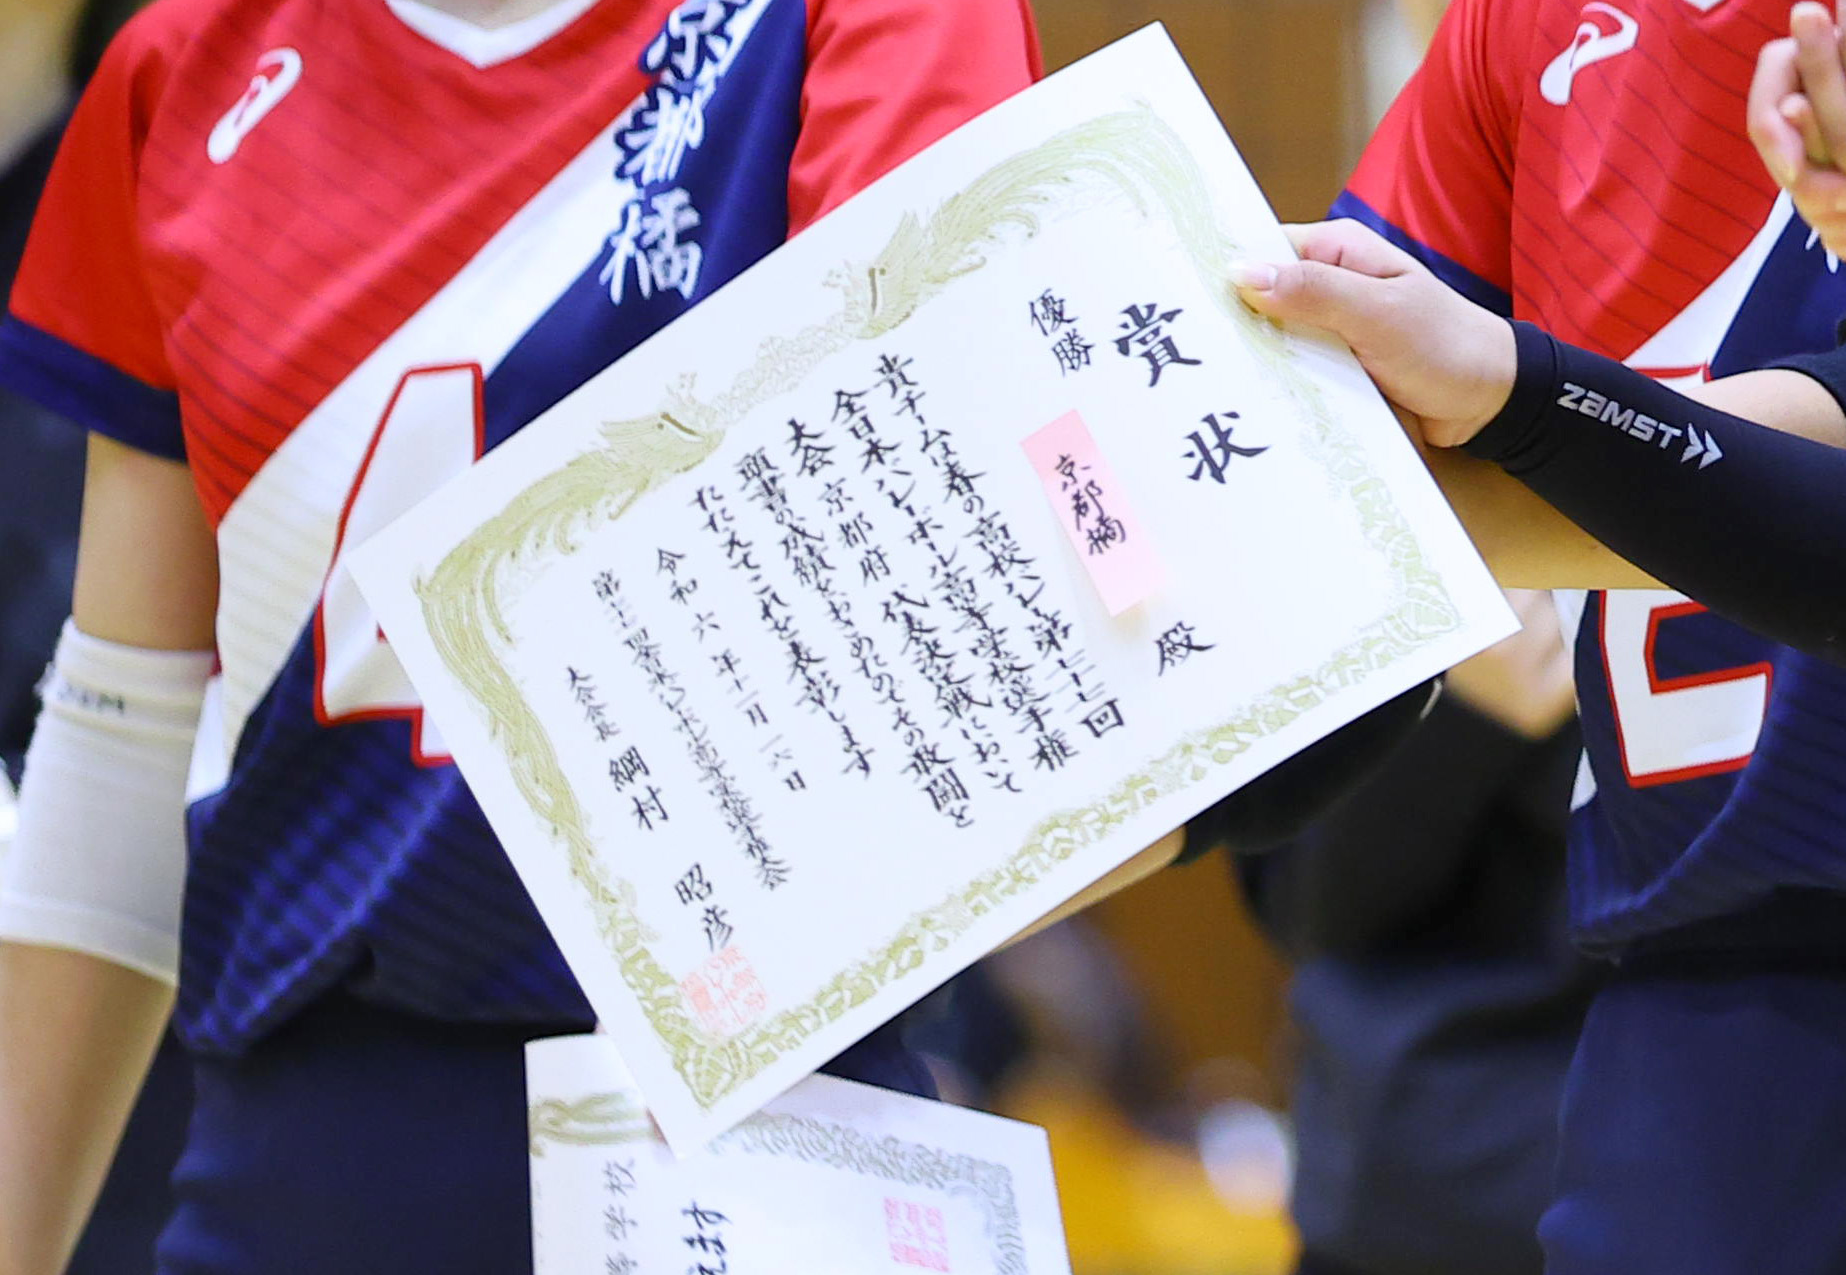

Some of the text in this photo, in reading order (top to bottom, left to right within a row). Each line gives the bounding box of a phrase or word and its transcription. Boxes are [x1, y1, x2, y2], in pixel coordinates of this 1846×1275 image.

[1029, 288, 1094, 373] 優勝
[1112, 303, 1268, 484] 賞状
[1154, 621, 1214, 675] 殿
